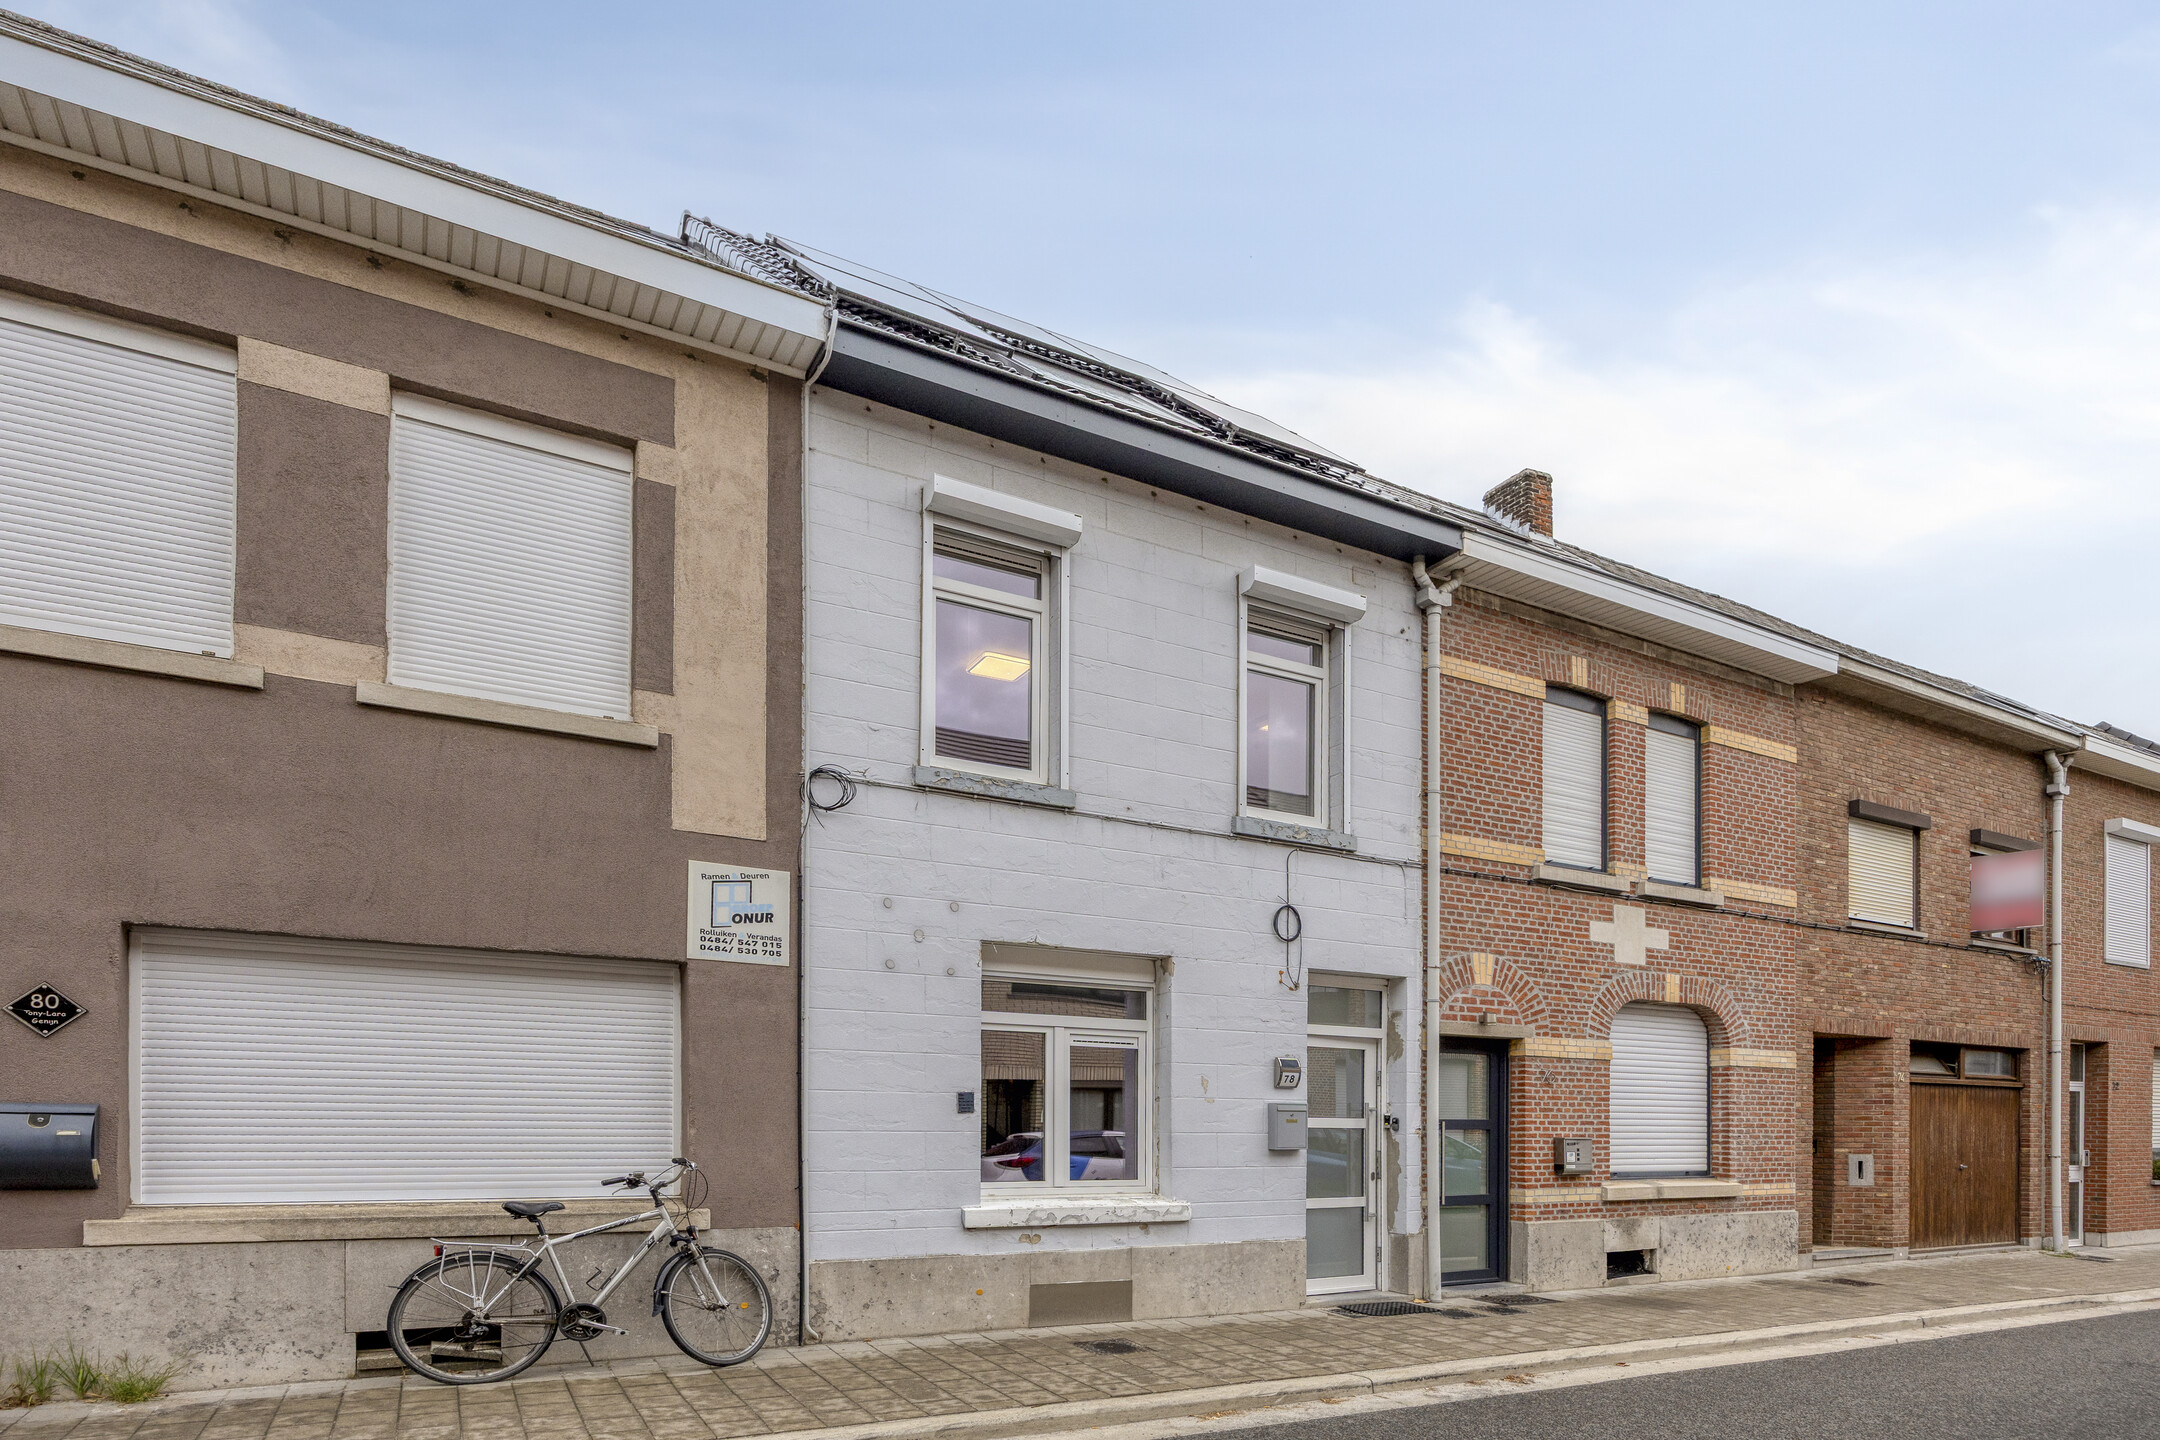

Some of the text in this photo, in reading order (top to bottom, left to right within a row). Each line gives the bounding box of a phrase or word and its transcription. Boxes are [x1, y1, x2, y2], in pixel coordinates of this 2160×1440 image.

[740, 872, 770, 880] Deuren
[732, 913, 774, 924] ONUR
[700, 929, 737, 938] Rolluiken
[746, 932, 782, 942] Verandas
[700, 935, 782, 949] 0484/ 547 015
[700, 944, 734, 954] 0484/
[737, 947, 758, 955] 530
[761, 949, 782, 957] 705
[30, 993, 60, 1009] 80
[1283, 1074, 1296, 1084] 78
[1897, 1071, 1905, 1083] 74
